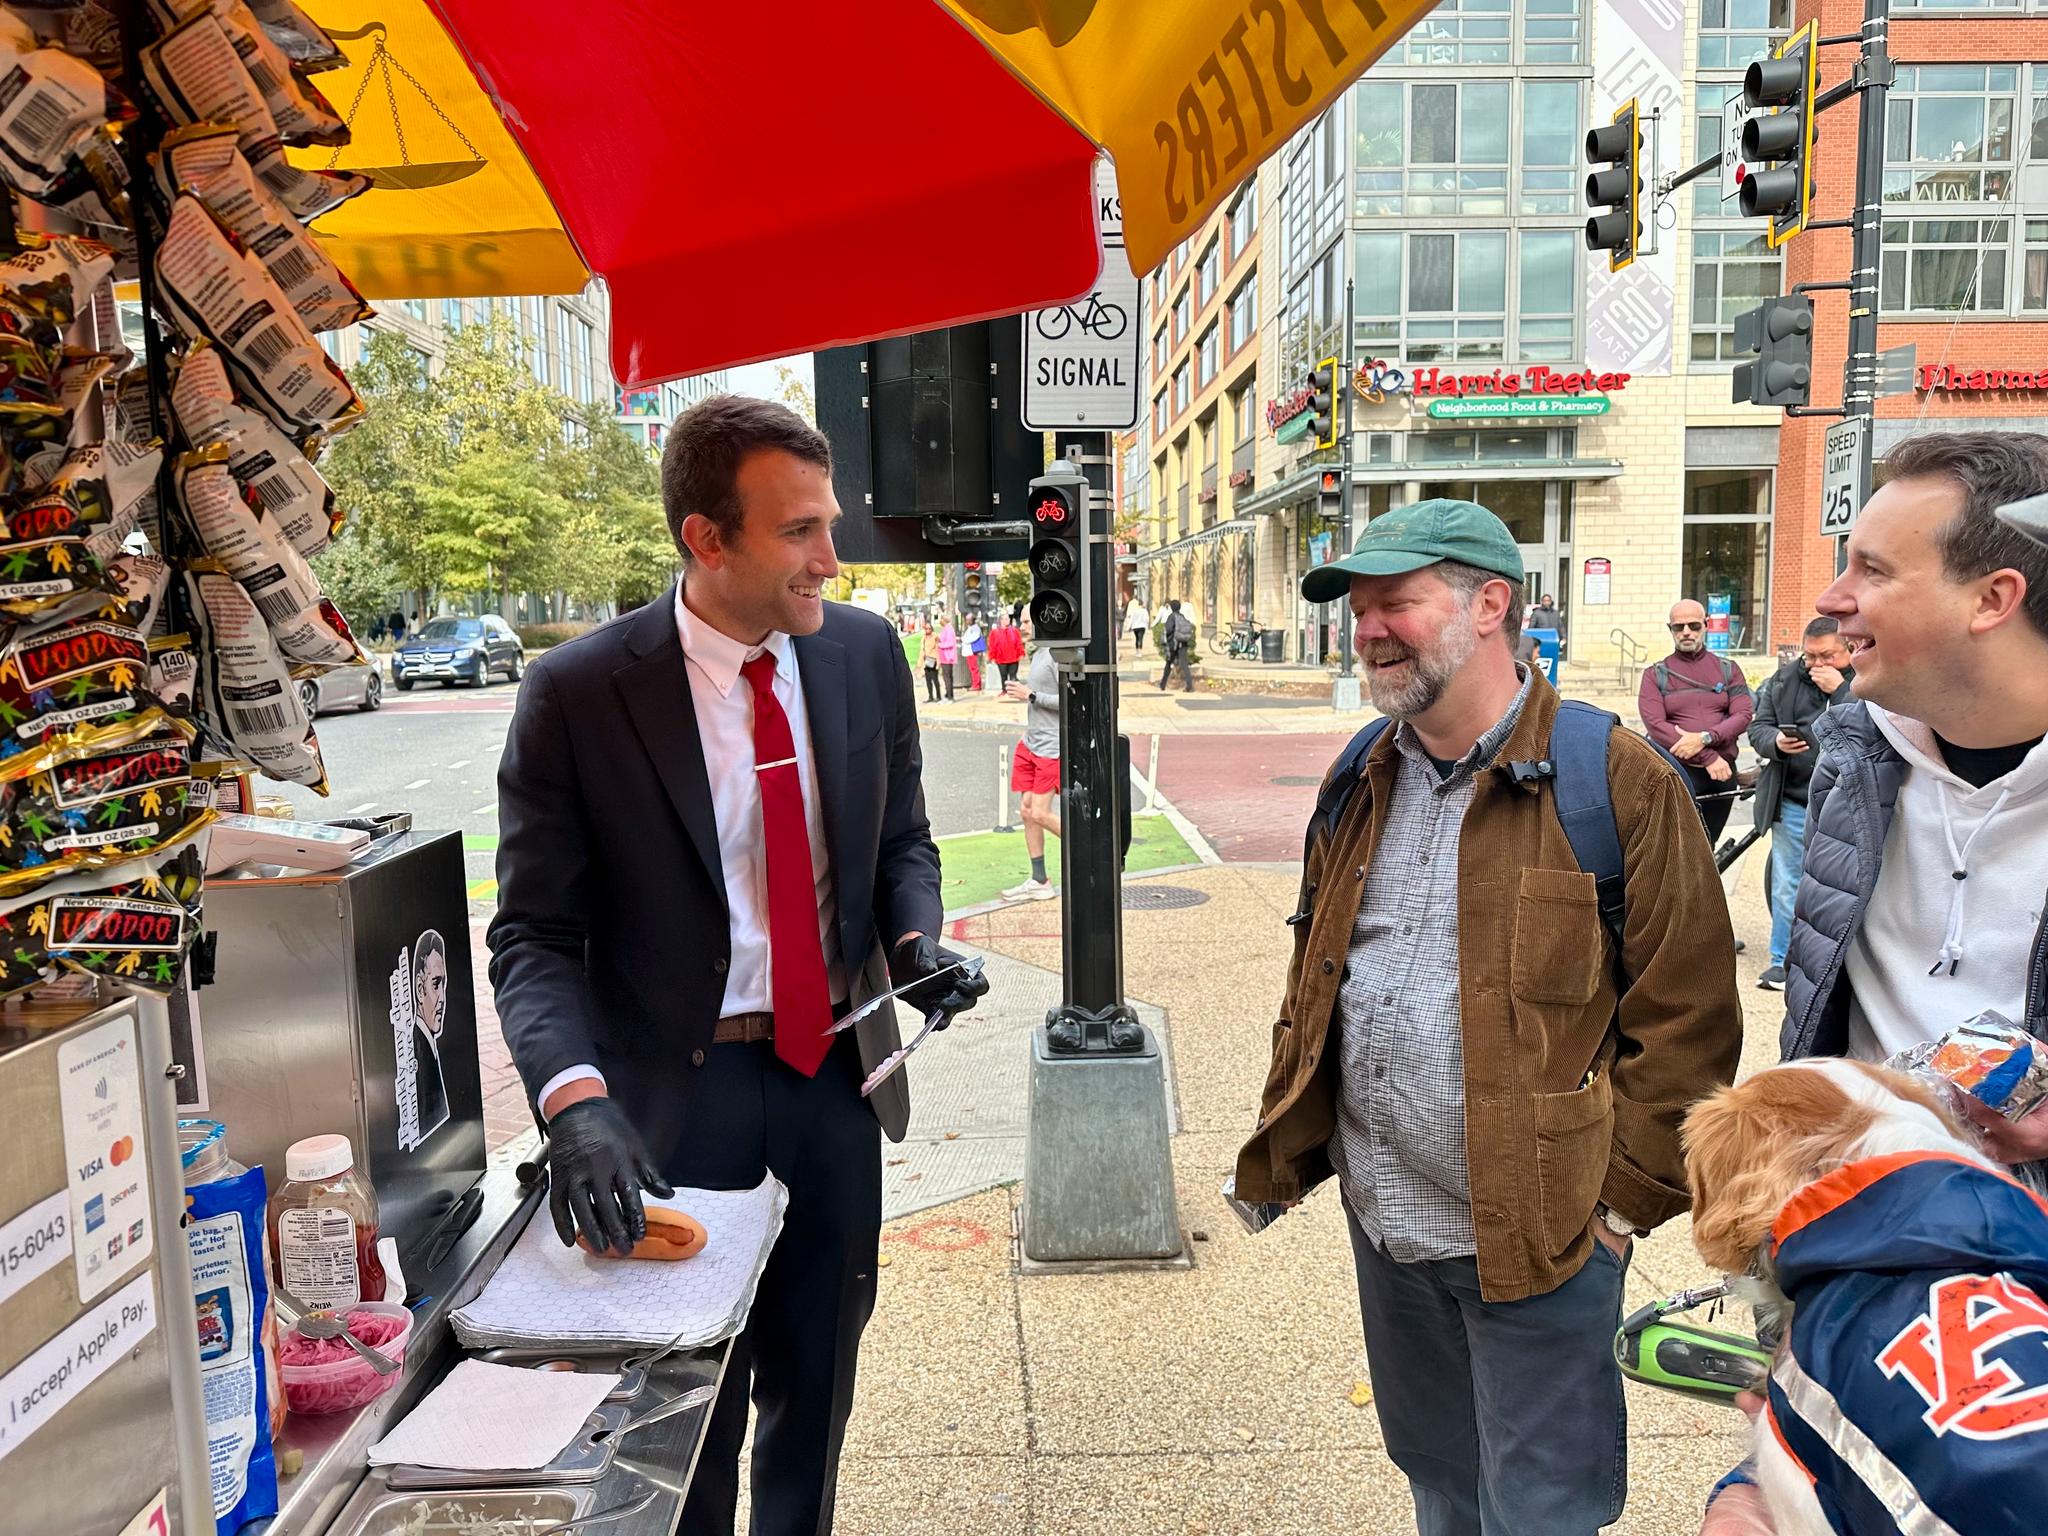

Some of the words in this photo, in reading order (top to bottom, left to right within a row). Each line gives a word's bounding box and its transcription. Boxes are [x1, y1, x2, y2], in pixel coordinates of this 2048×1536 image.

[1725, 149, 1737, 167] ON
[1603, 286, 1663, 352] 130
[1589, 319, 1631, 362] FLATS
[1037, 357, 1126, 386] SIGNAL
[1412, 367, 1520, 396] Harris
[1525, 364, 1630, 394] Teeter
[1436, 401, 1509, 415] Neighborhood
[1511, 401, 1536, 412] Food
[1538, 401, 1549, 412] &
[1551, 401, 1605, 413] Pharmacy
[1828, 431, 1857, 455] SPEED
[1829, 453, 1852, 475] LIMIT
[1825, 484, 1852, 527] 25
[23, 637, 44, 648] New
[47, 628, 83, 644] Orleans
[114, 627, 136, 638] Style
[28, 633, 141, 675] VOODOO
[162, 652, 185, 667] 140
[28, 719, 47, 732] NET
[75, 708, 91, 718] OZ
[93, 702, 127, 716] (28.3g)
[153, 741, 178, 749] Style
[62, 750, 181, 794] VOODOO
[188, 782, 208, 795] 40
[78, 836, 94, 844] WT
[104, 833, 119, 842] OZ
[121, 828, 152, 840] (28.3g)
[63, 898, 84, 906] New
[126, 902, 151, 912] Kettle
[152, 904, 172, 913] Style
[62, 910, 172, 941] VOODOO
[391, 972, 402, 1022] dear,
[395, 1029, 405, 1058] my
[405, 1034, 417, 1074] give
[69, 1062, 84, 1074] BANK
[93, 1047, 116, 1062] AMERICA
[397, 1066, 409, 1142] Frankly
[78, 1158, 104, 1181] VISA
[193, 1246, 214, 1256] taste
[210, 1235, 225, 1243] Hot
[22, 1358, 72, 1414] accept
[77, 1320, 118, 1368] Apple
[122, 1300, 148, 1329] Pay.
